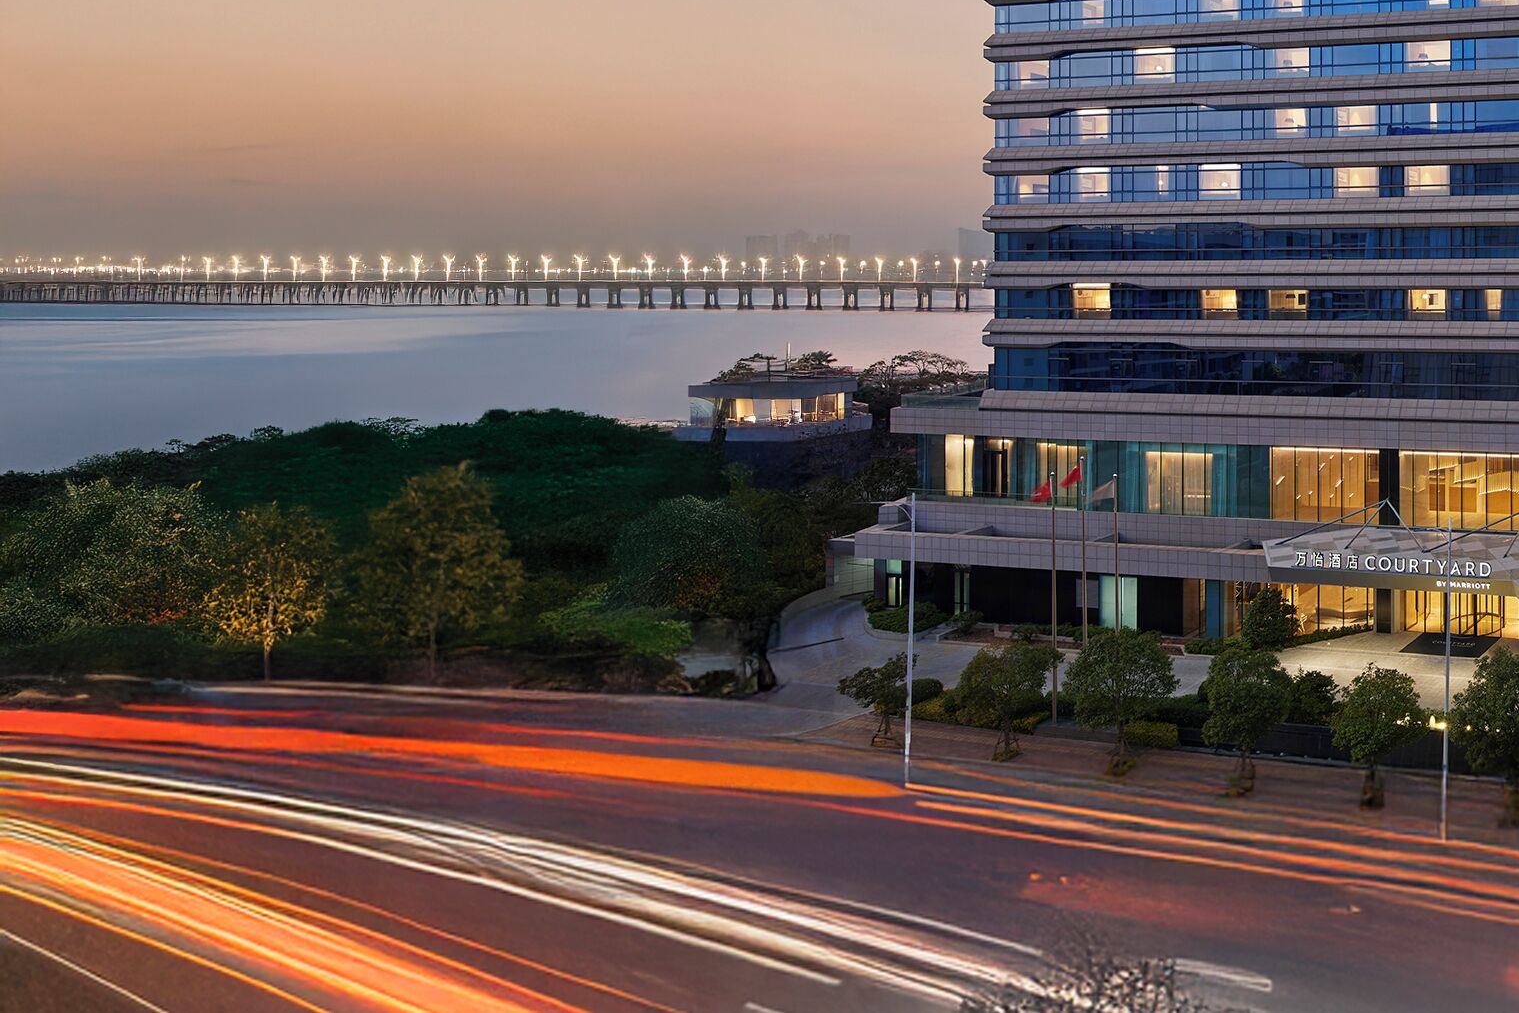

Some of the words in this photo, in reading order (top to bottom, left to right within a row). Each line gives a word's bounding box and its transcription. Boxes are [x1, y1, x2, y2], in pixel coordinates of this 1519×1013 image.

[1295, 551, 1359, 570] 万怡酒店
[1364, 555, 1492, 577] COURTYARD
[1449, 581, 1491, 589] MARRIOTT
